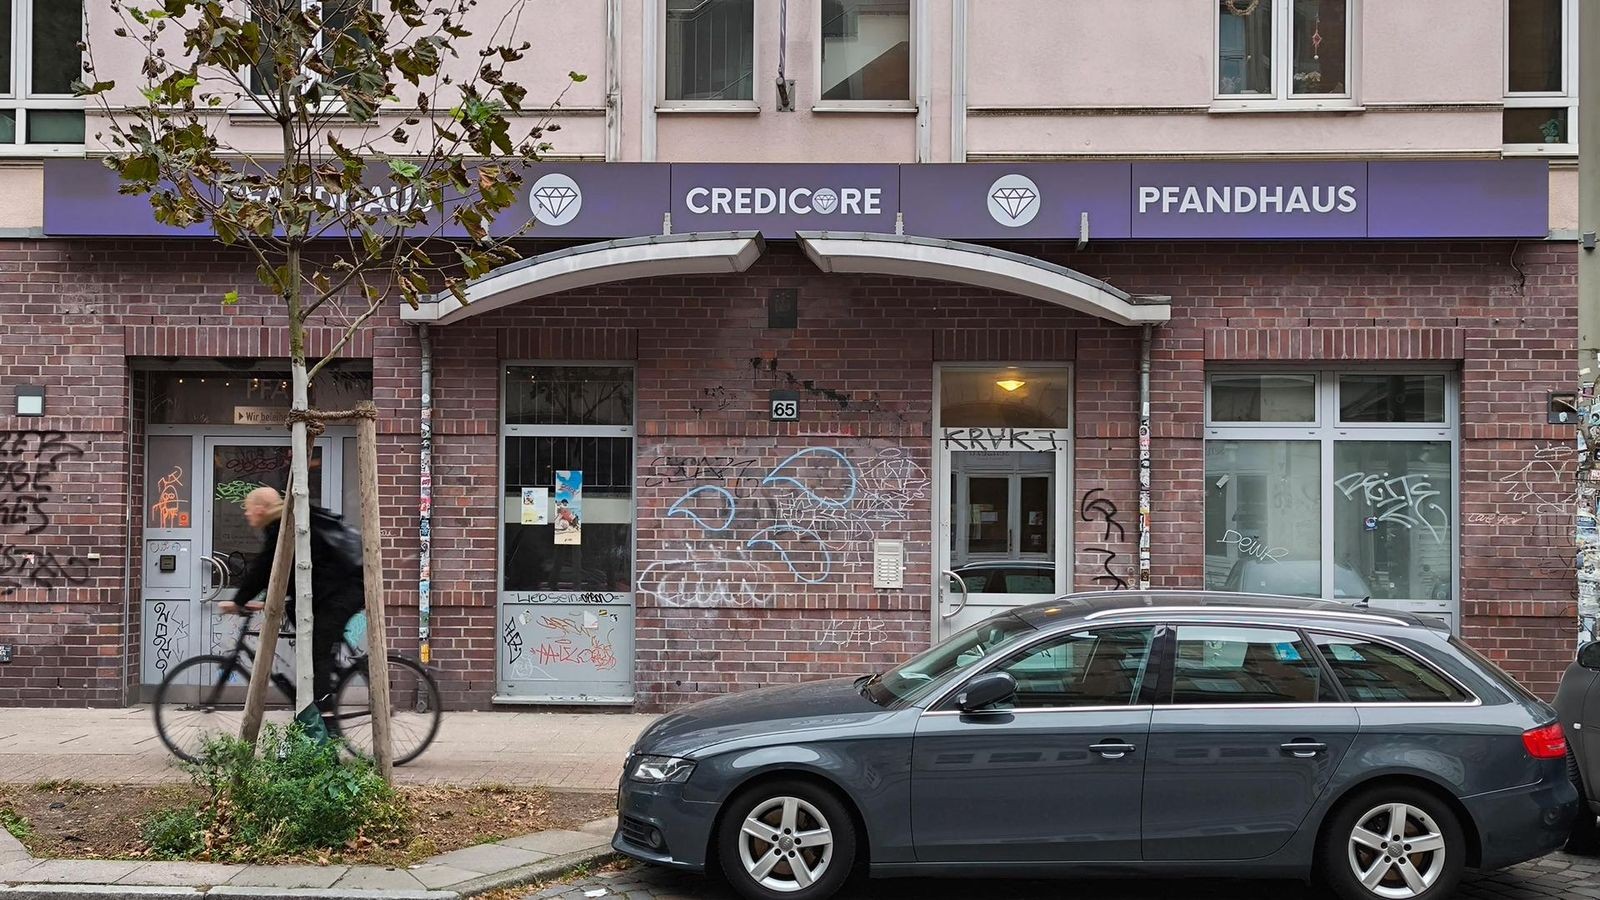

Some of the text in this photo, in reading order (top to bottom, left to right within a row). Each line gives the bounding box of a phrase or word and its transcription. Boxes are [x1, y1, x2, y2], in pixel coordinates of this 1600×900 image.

[685, 187, 881, 214] CREDICORE
[1139, 186, 1357, 213] PFANDHAUS
[246, 411, 259, 422] Wir
[774, 402, 795, 419] 65
